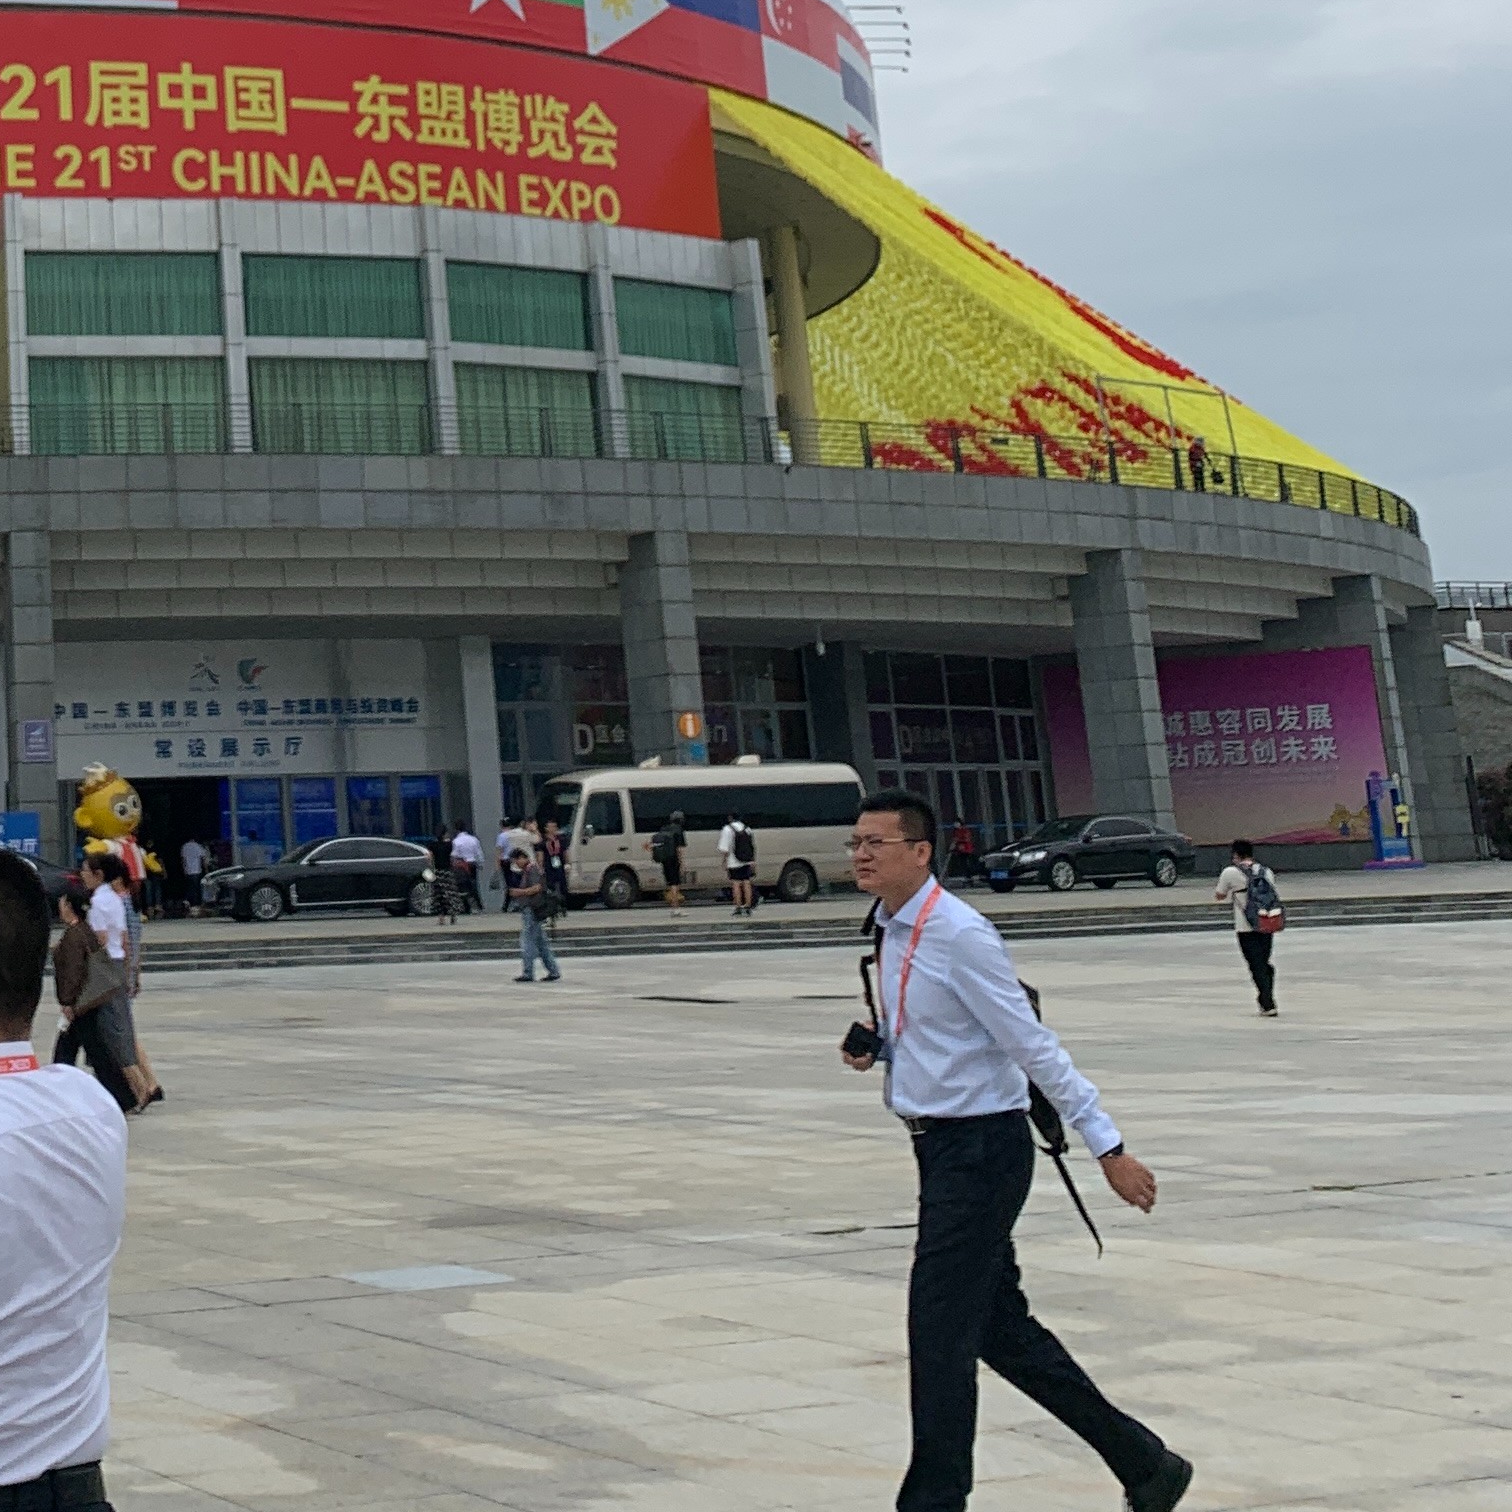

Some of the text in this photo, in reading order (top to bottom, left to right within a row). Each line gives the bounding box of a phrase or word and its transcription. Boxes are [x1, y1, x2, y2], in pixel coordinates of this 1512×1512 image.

[55, 145, 153, 189] 21ST
[172, 147, 506, 212] CHINA-ASEAN
[518, 174, 621, 226] EXPO
